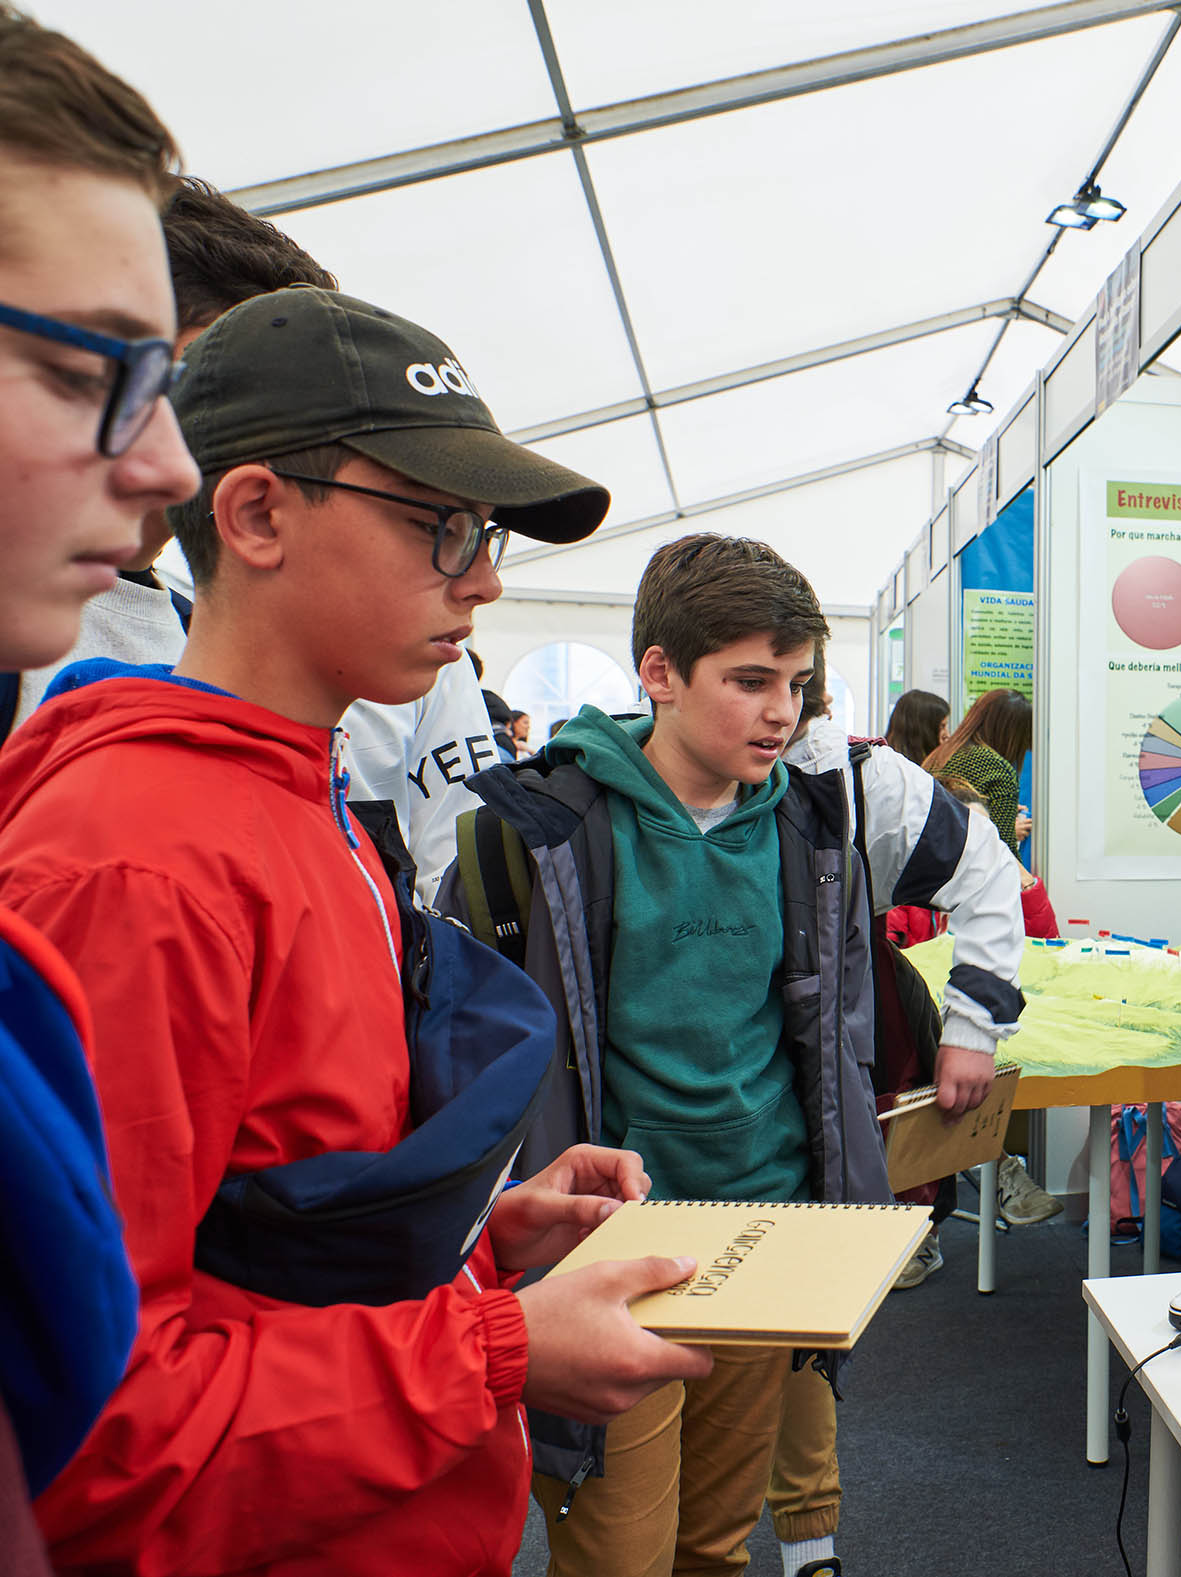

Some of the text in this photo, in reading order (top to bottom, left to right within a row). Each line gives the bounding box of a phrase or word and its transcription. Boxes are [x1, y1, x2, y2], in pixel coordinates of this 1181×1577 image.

[1110, 528, 1126, 539] Por
[1128, 530, 1144, 541] que
[980, 596, 1002, 605] VIDA
[1108, 661, 1126, 672] Que
[971, 670, 1011, 679] MUNDIAL
[1013, 671, 1026, 680] DA
